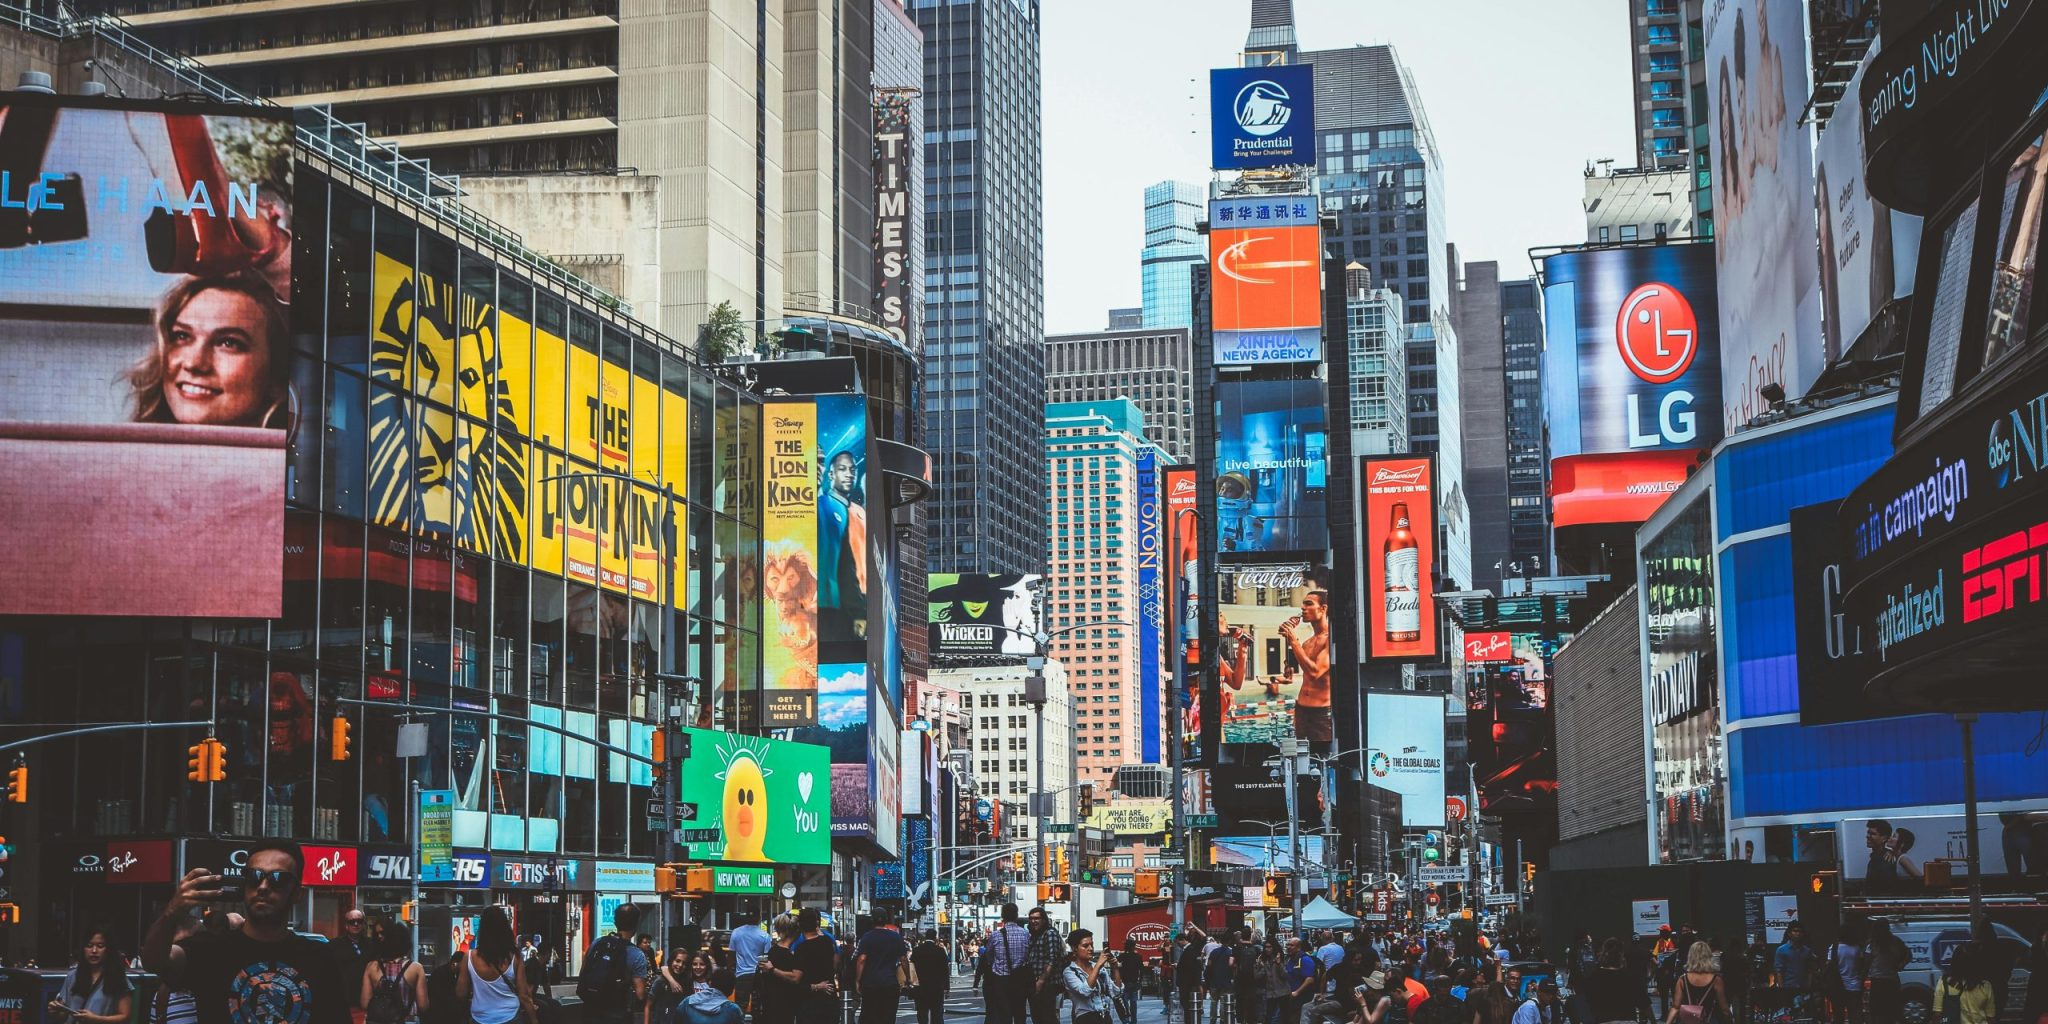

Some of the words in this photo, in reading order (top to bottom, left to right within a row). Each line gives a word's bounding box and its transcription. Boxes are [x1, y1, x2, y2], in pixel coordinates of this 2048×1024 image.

[1922, 9, 1976, 83] Night
[1233, 137, 1292, 149] Prudential
[97, 176, 258, 219] HAAN
[879, 133, 904, 278] TIMES
[1219, 203, 1307, 221] 新华通讯社
[1839, 231, 1860, 271] future
[1237, 335, 1299, 349] XINHUA
[1223, 350, 1259, 361] NEWS
[1261, 348, 1314, 360] AGENCY
[586, 395, 628, 453] THE
[772, 416, 803, 429] Disney
[1627, 390, 1696, 448] LG
[774, 441, 802, 453] THE
[1988, 436, 2011, 469] abc
[770, 456, 808, 479] LION
[1225, 458, 1250, 470] Live
[1254, 457, 1312, 469] beautiful
[1177, 481, 1196, 491] Bud
[1376, 471, 1420, 481] Budweiser
[541, 435, 608, 539] LION
[767, 481, 813, 507] KING
[1383, 486, 1402, 494] BUD'S
[1869, 503, 1881, 552] in
[1884, 456, 1968, 541] campaign
[1137, 466, 1157, 569] NOVOTEL
[569, 559, 596, 578] ENTRANCE
[602, 569, 611, 582] ON
[613, 572, 626, 586] 45TH
[631, 578, 648, 592] STREET
[1237, 569, 1303, 589] Coca-Cola
[1386, 596, 1420, 612] Bud
[1467, 635, 1508, 657] Ray-Ban
[1649, 670, 1669, 727] OLD
[1670, 650, 1699, 719] NAVY
[1392, 757, 1403, 767] THE
[1403, 758, 1423, 768] GLOBAL
[1423, 758, 1441, 768] GOALS
[849, 823, 868, 831] MAD
[1129, 822, 1153, 830] THERE?
[1186, 816, 1193, 825] W
[1196, 816, 1207, 825] 44
[686, 831, 694, 841] W
[698, 831, 708, 841] 44
[108, 851, 138, 873] Ray-Ban
[223, 867, 242, 876] OAK
[317, 851, 346, 881] Ray-Ban
[523, 863, 568, 884] TISST
[717, 873, 733, 887] NEW
[733, 873, 750, 887] YORK
[758, 874, 772, 887] LINE
[1377, 890, 1386, 911] tkts
